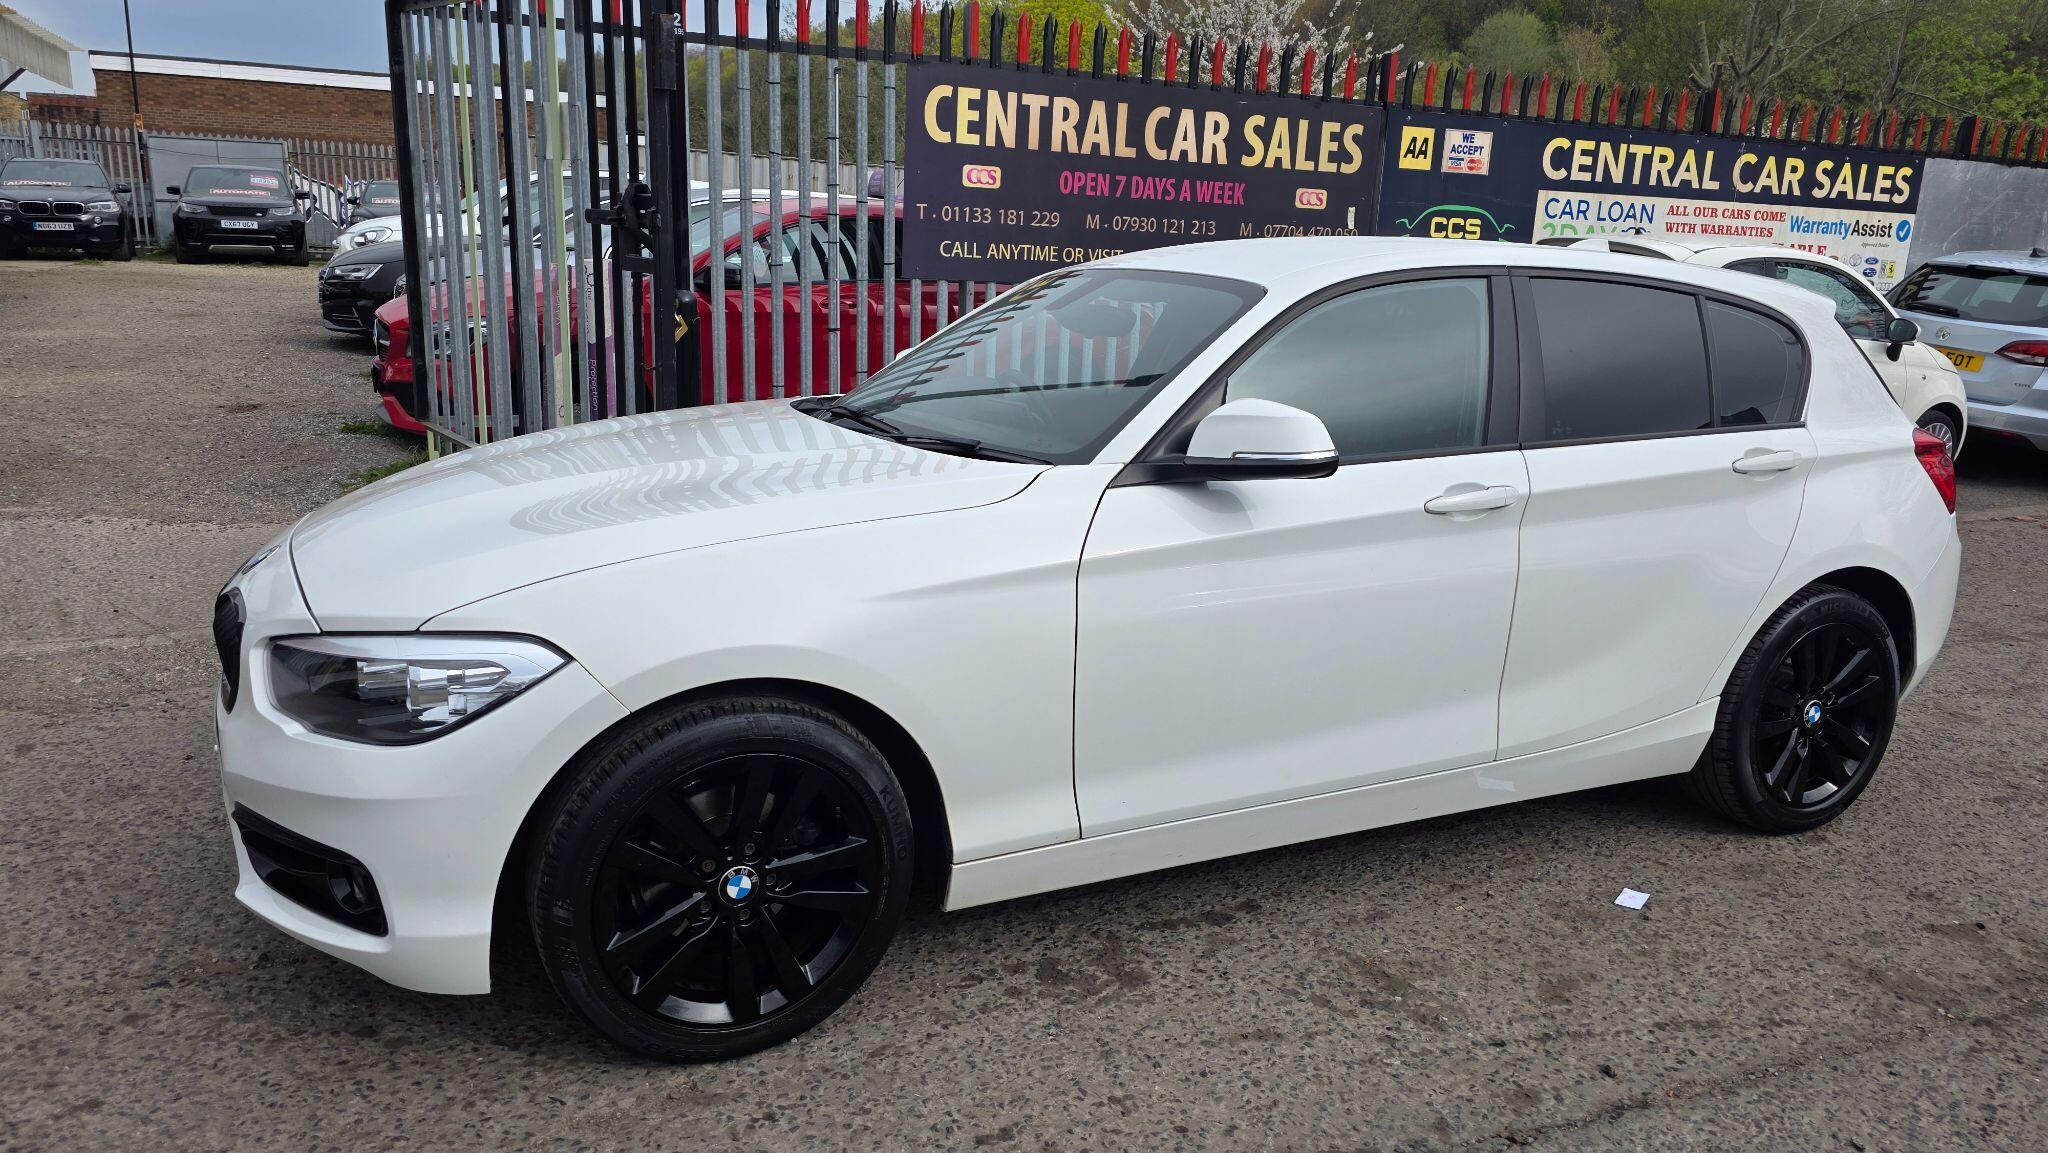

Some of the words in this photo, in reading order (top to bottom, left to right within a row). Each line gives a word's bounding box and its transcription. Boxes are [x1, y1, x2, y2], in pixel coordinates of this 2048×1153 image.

[673, 12, 682, 27] 2
[924, 84, 1137, 158] CENTRAL
[1144, 106, 1230, 165] CAR
[1241, 114, 1364, 175] SALES
[1462, 132, 1476, 144] WE
[1403, 136, 1429, 160] AA
[1450, 144, 1485, 156] ACCEPT
[966, 168, 997, 186] CCS
[1542, 137, 1720, 190] CENTRAL
[1732, 153, 1805, 196] CAR
[1811, 159, 1914, 204] SALES
[1059, 170, 1110, 197] OPEN
[1115, 175, 1127, 198] 7
[1131, 175, 1176, 201] DAYS
[1179, 179, 1191, 202] A
[1196, 180, 1246, 206] WEEK
[1299, 191, 1324, 206] CCS
[941, 205, 992, 224] 01133
[998, 209, 1025, 226] 181
[1030, 211, 1060, 228] 229
[1544, 197, 1590, 221] CAR
[1596, 200, 1656, 224] LOAN
[1666, 204, 1689, 217] ALL
[1693, 206, 1719, 219] OUR
[1721, 208, 1751, 220] CARS
[1753, 210, 1787, 223] COME
[1112, 215, 1157, 233] 07930
[1162, 218, 1185, 234] 121
[1190, 220, 1217, 236] 213
[1264, 224, 1304, 238] 07704
[1430, 216, 1482, 240] CCS
[1665, 221, 1698, 234] WITH
[1700, 223, 1774, 238] WARRANTIES
[940, 240, 982, 259] CALL
[987, 243, 1059, 262] ANYTIME
[1062, 247, 1084, 263] OR
[590, 359, 599, 411] Protection
[727, 867, 759, 884] BMW
